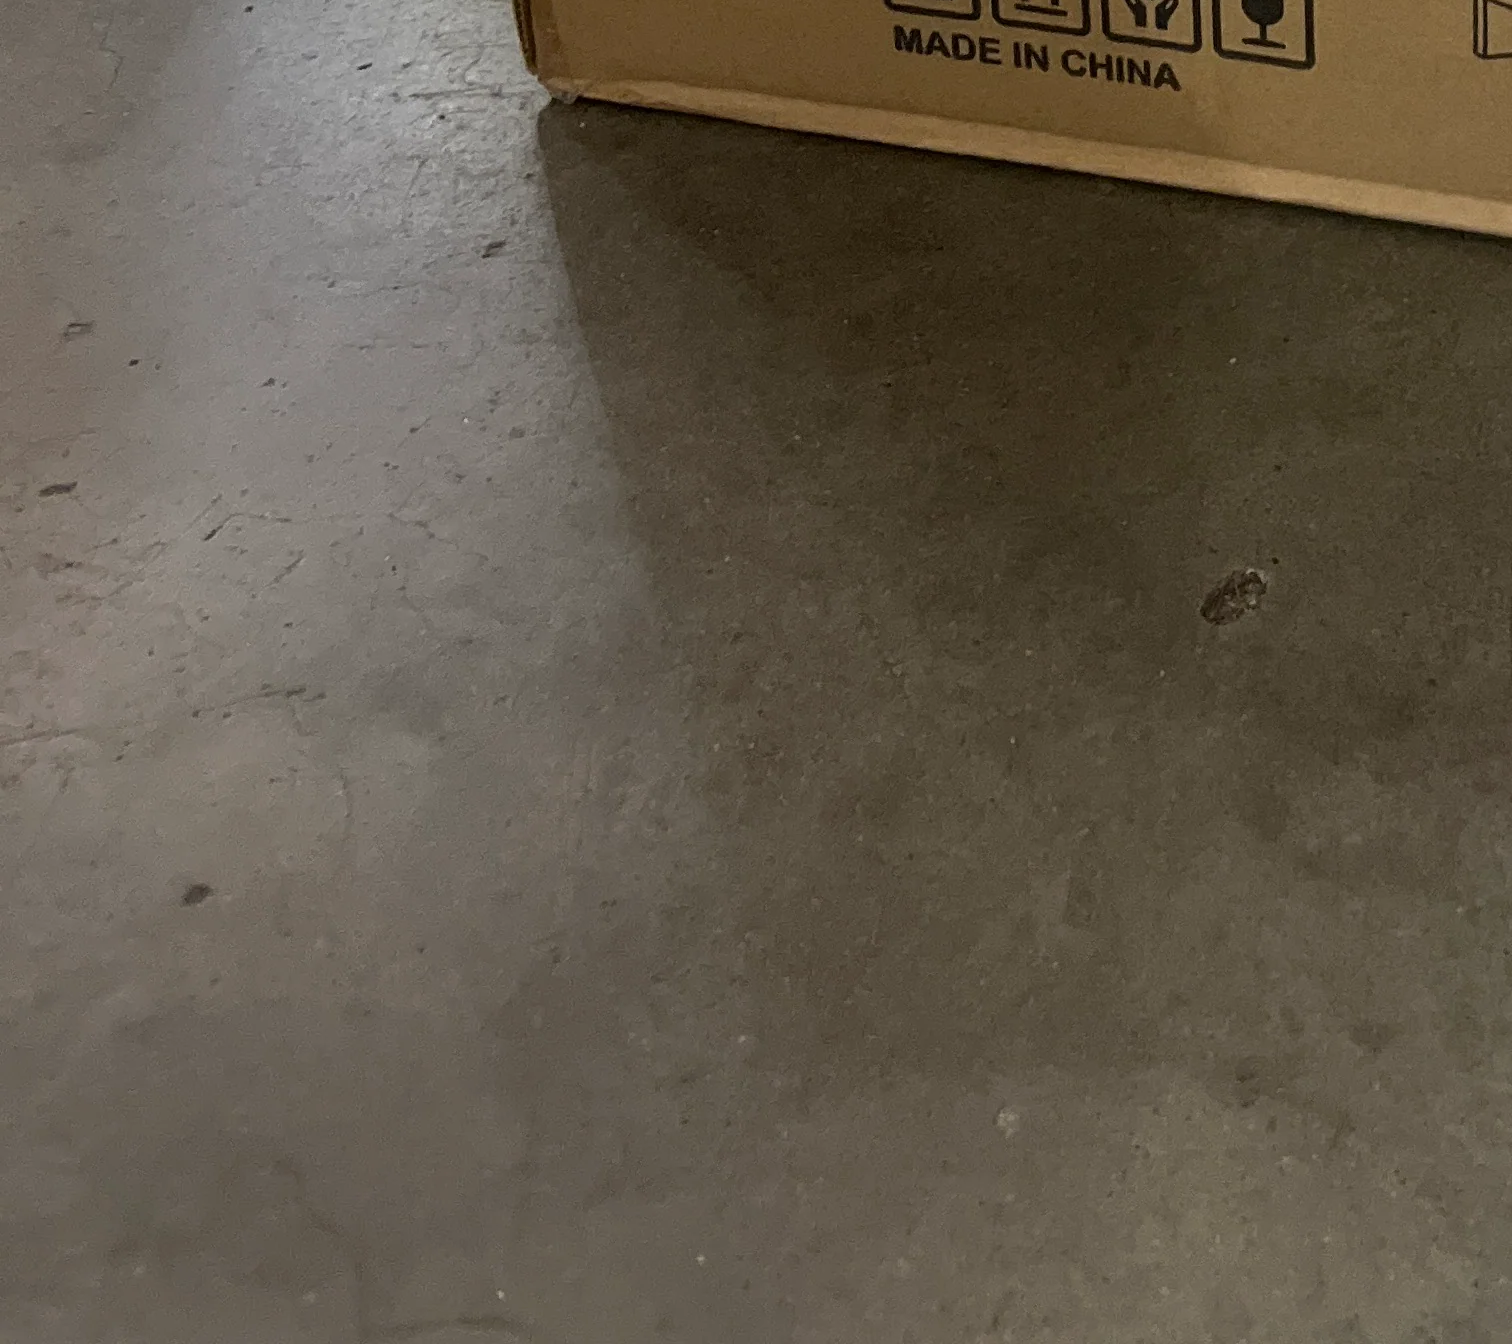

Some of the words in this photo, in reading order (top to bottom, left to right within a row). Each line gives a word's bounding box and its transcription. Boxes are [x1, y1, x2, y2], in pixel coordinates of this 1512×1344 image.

[893, 25, 1003, 65] MADE
[1013, 42, 1050, 72] IN
[1061, 49, 1182, 92] CHINA
